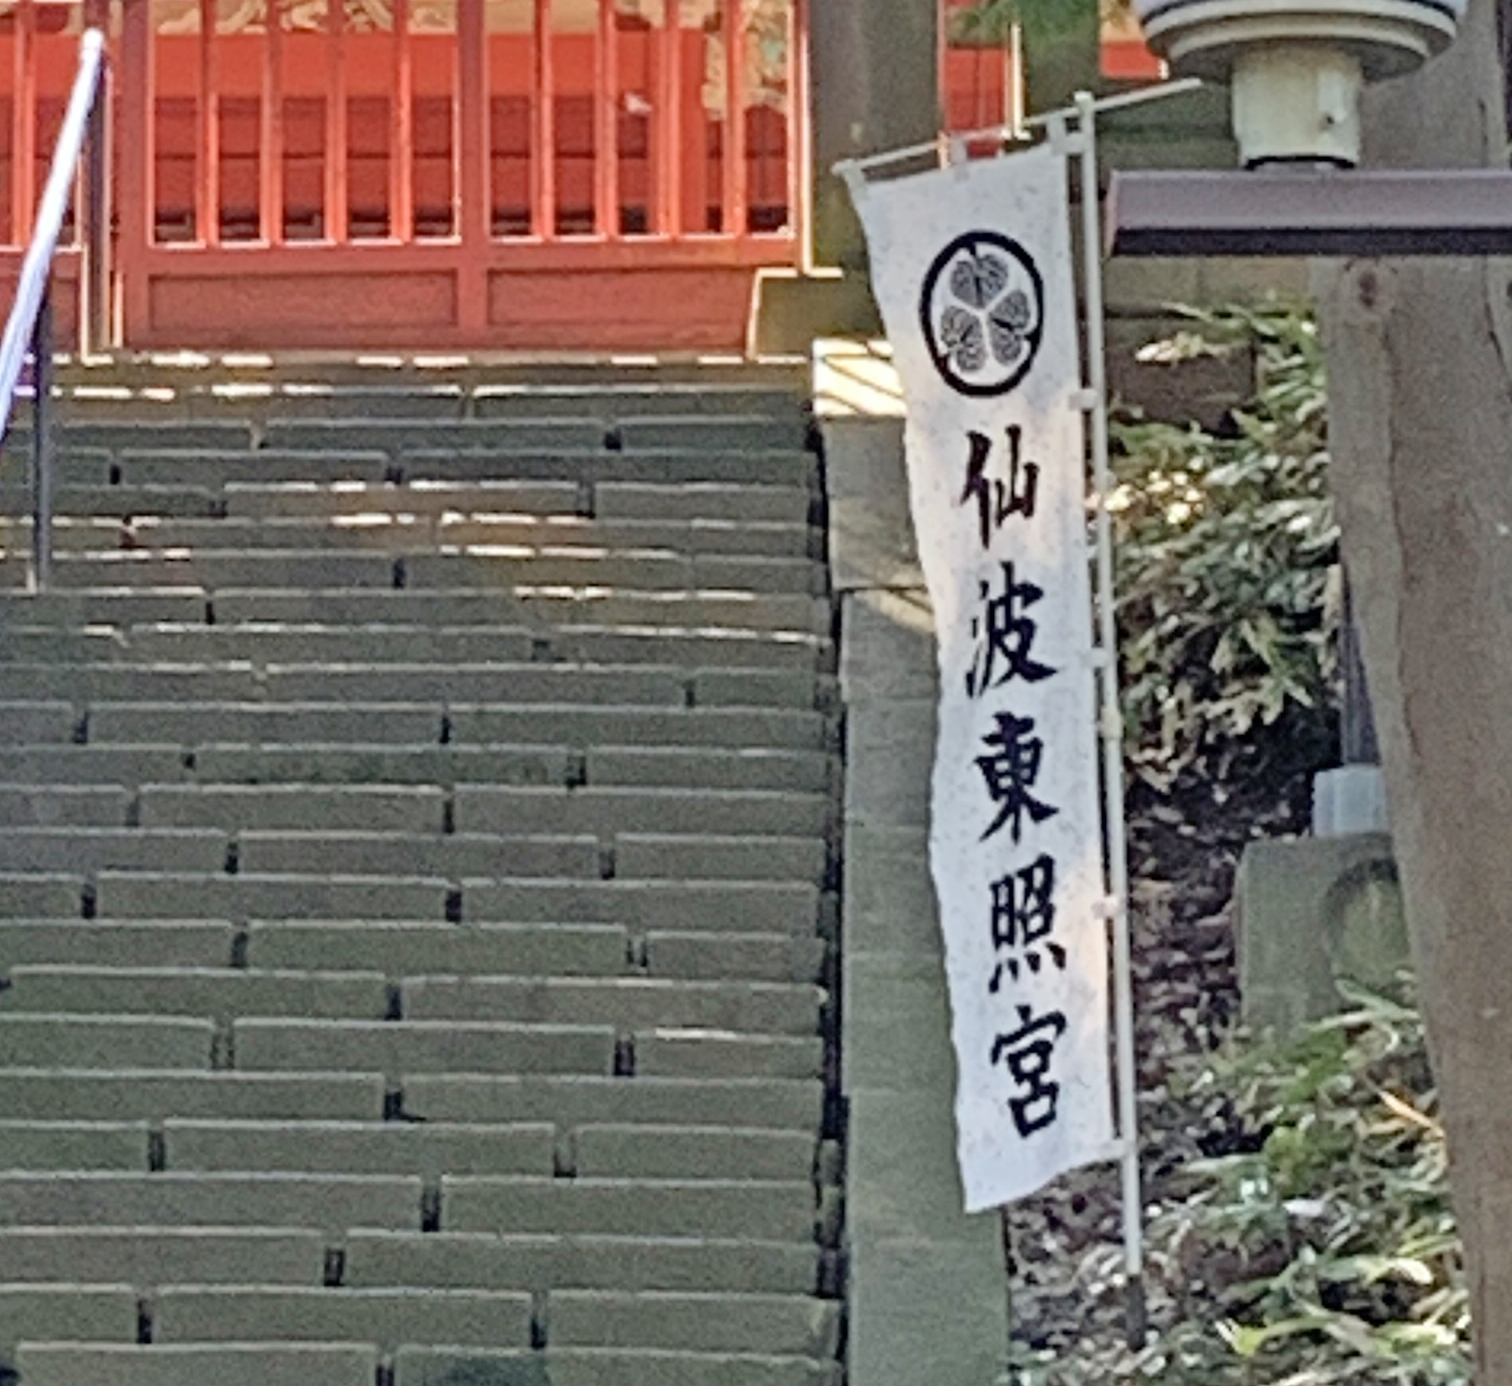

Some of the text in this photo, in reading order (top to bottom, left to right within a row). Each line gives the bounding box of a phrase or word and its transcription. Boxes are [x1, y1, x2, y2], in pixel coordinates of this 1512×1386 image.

[958, 422, 1069, 1139] 仙波東照宮
